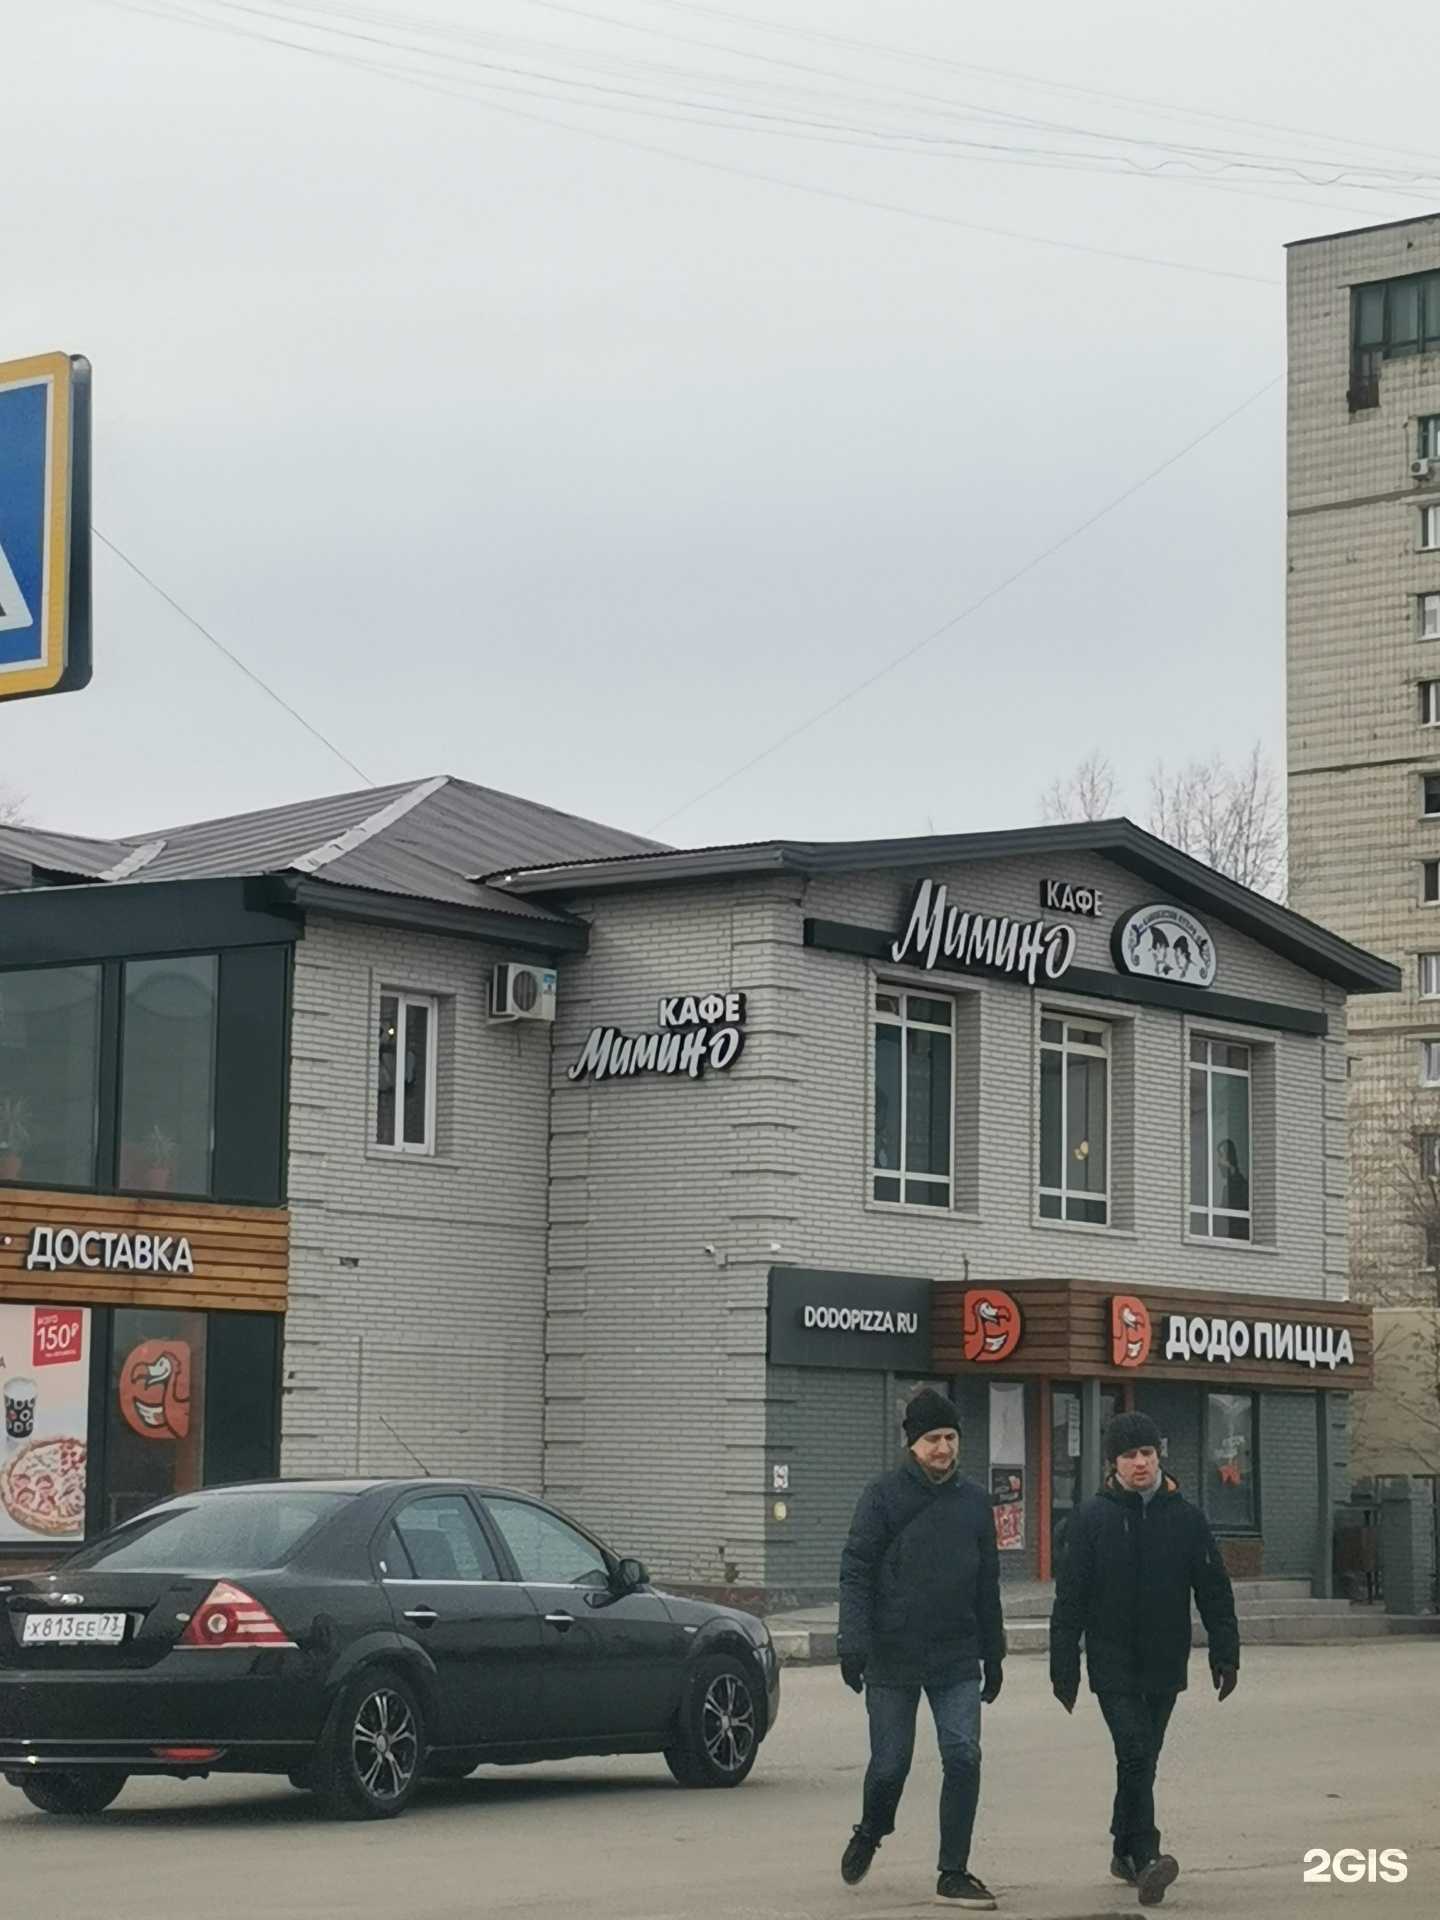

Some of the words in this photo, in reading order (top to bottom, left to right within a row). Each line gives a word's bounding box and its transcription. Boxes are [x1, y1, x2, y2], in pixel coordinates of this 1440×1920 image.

[1045, 879, 1104, 917] КАФЕ
[891, 878, 1077, 985] Мимино
[659, 993, 741, 1027] КАФЕ
[568, 1026, 740, 1080] Мимино
[26, 1226, 195, 1274] ДОСТАВКА
[1165, 1315, 1250, 1364] ДОДО
[1253, 1322, 1355, 1371] ПИЦЦА
